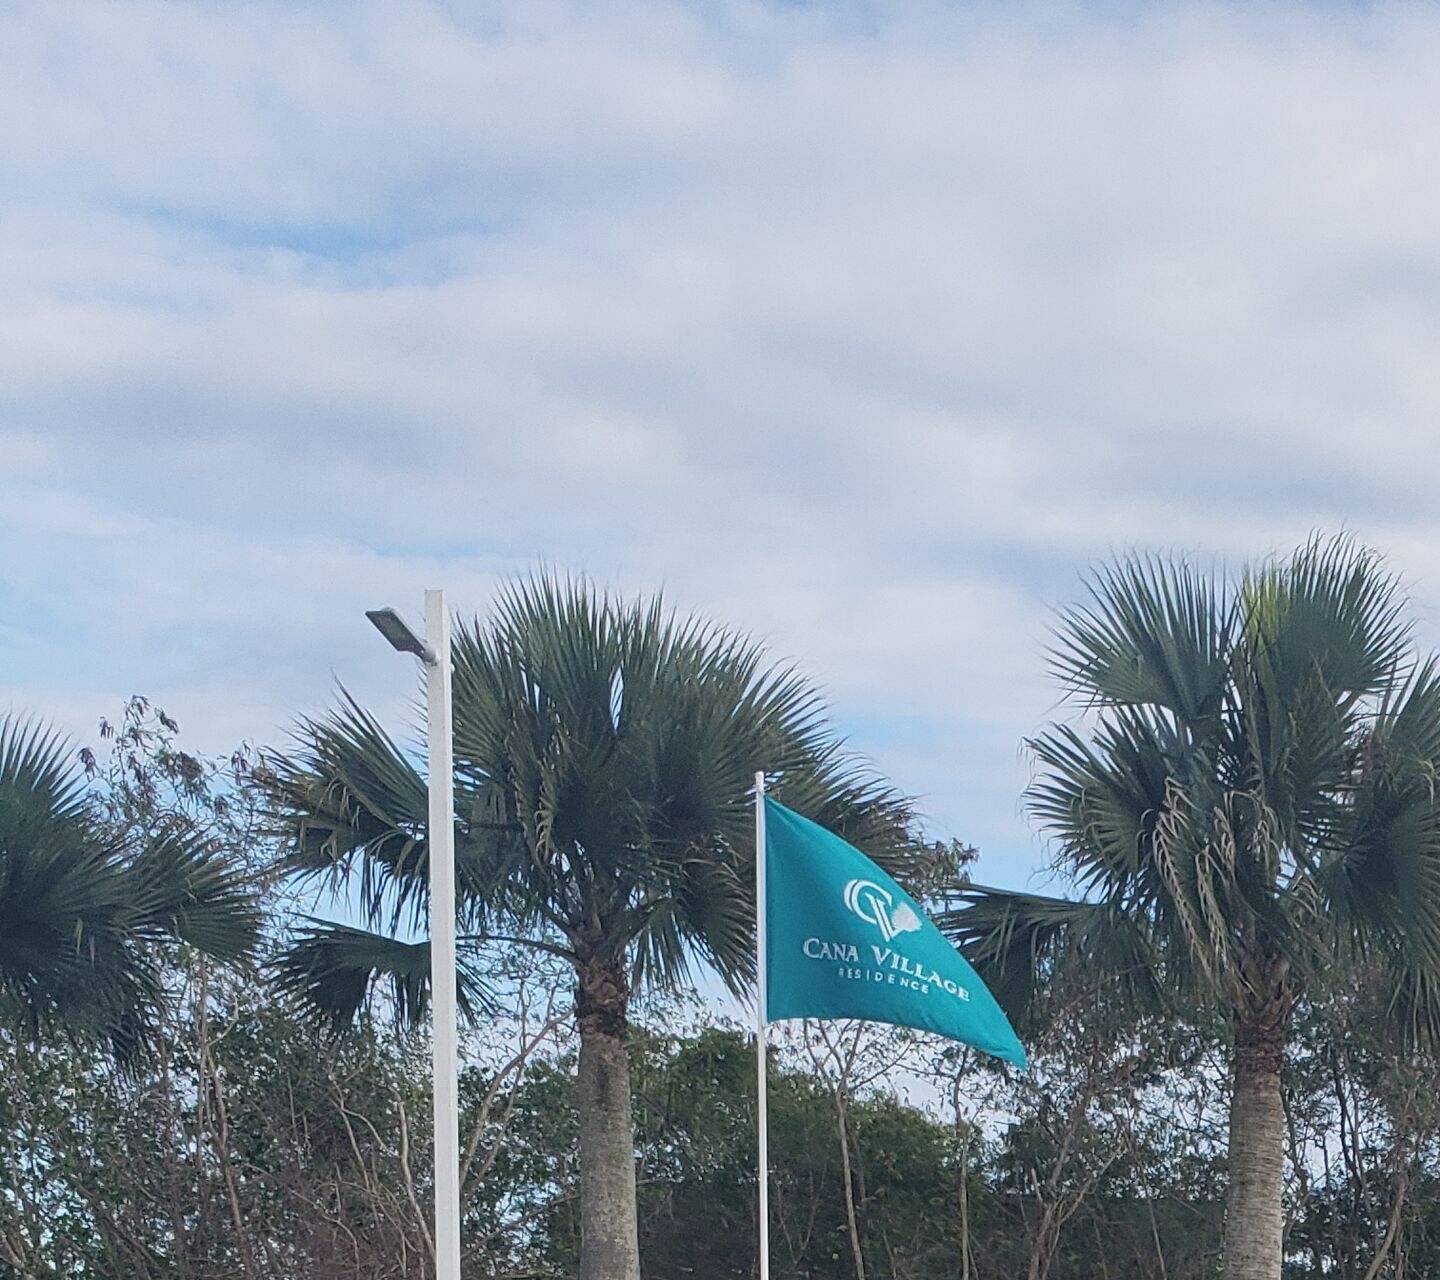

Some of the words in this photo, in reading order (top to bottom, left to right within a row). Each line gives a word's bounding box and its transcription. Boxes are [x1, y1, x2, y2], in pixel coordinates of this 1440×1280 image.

[803, 938, 859, 962] CANA
[872, 946, 970, 1002] VILLAGE
[838, 966, 929, 995] RESIDENCE
